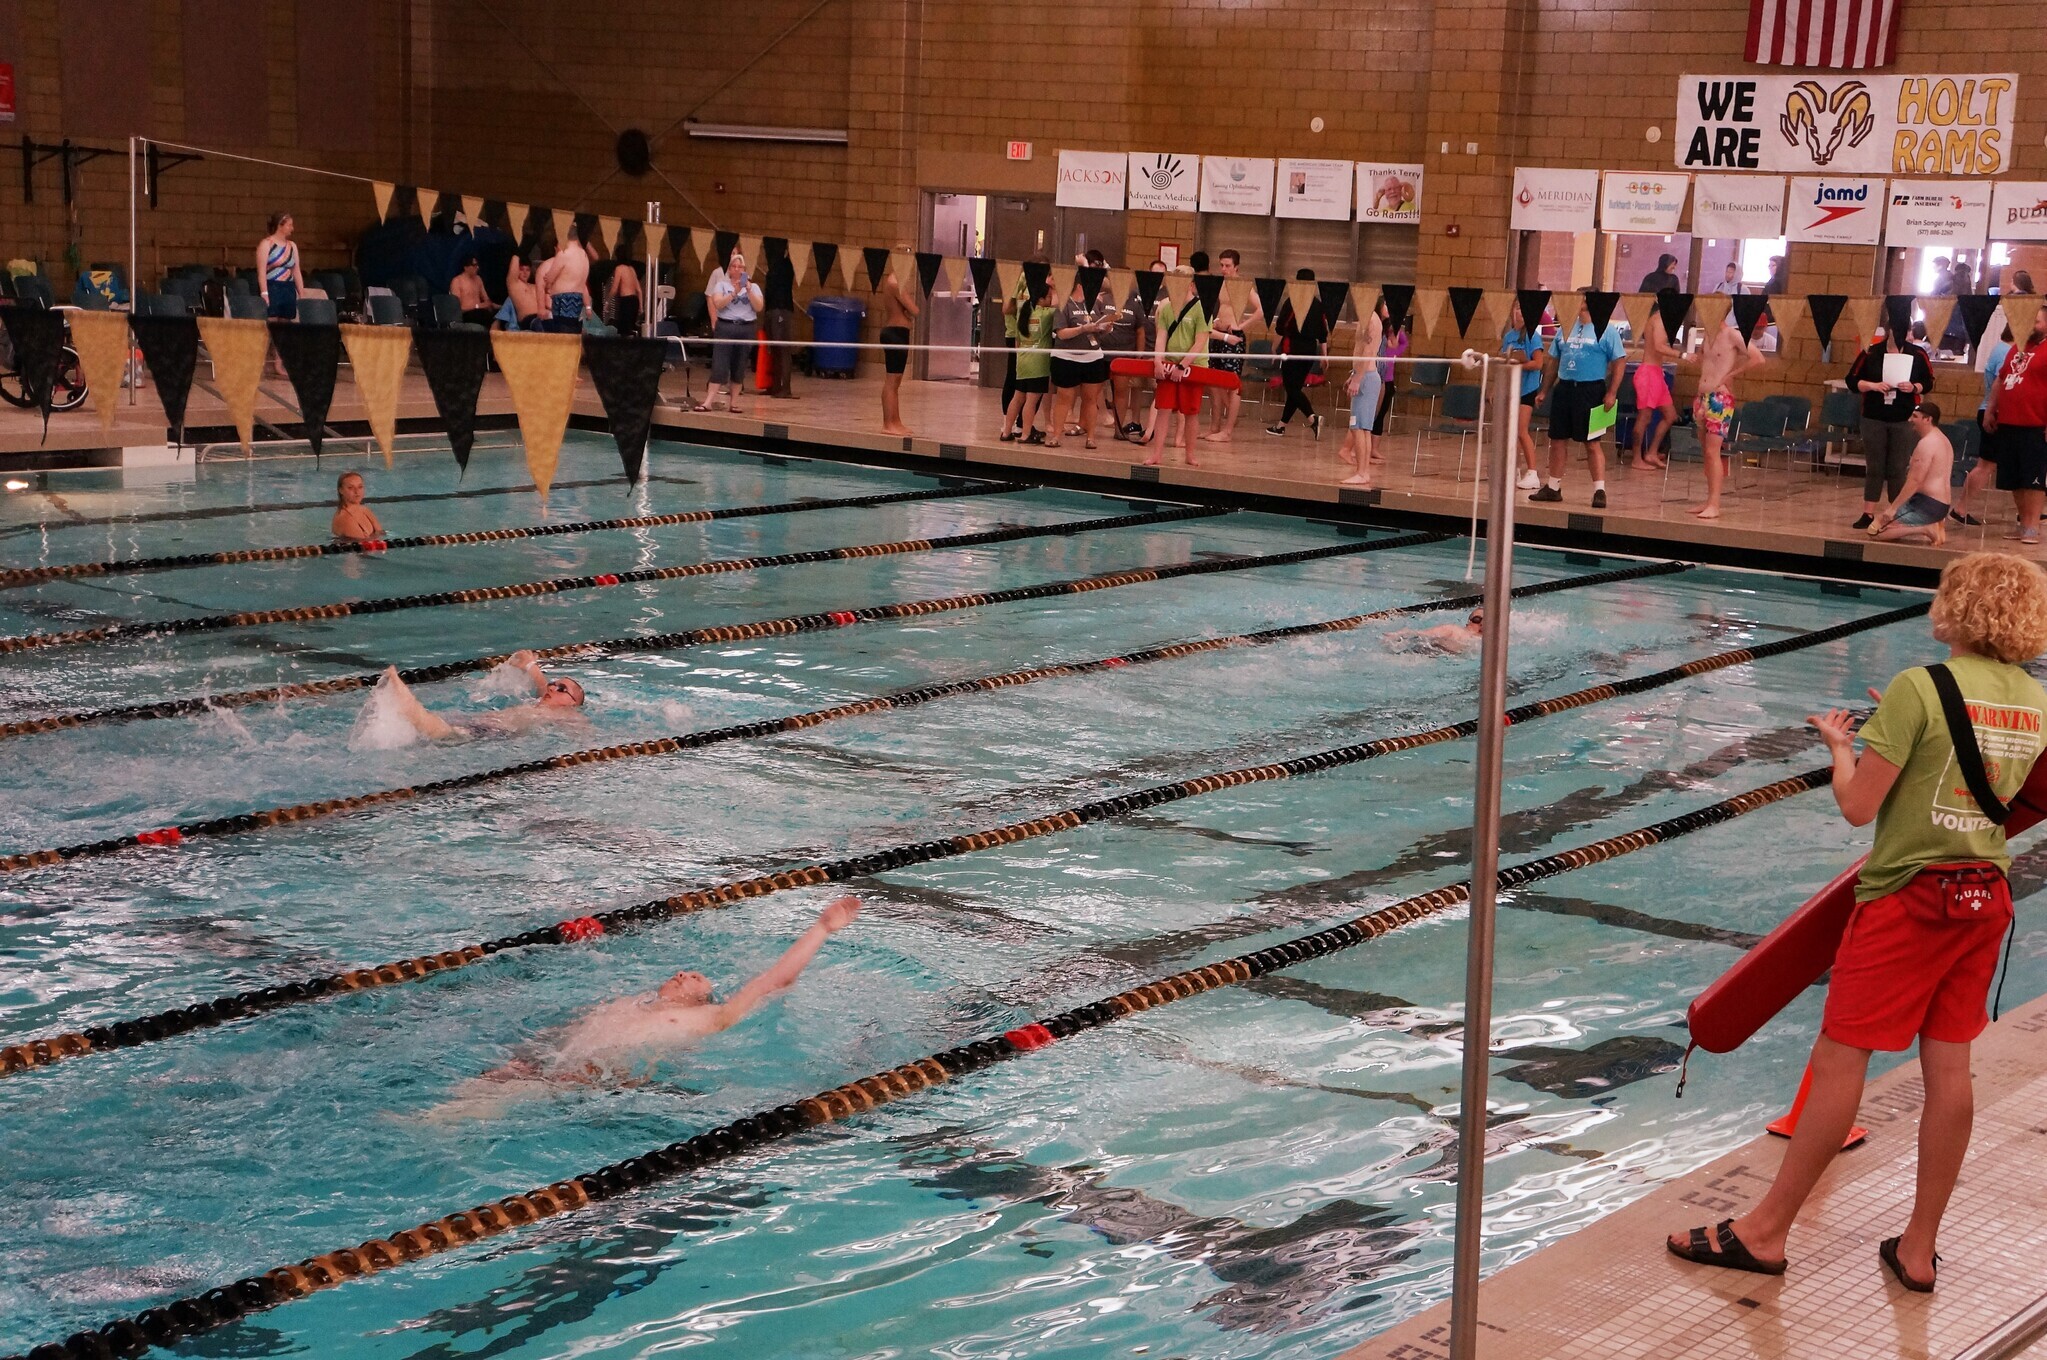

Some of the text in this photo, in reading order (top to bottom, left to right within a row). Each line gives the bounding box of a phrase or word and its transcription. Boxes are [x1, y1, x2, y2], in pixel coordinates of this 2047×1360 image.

[1698, 81, 1756, 122] WE
[1897, 78, 2011, 126] HOLT
[1011, 142, 1027, 158] EXIT
[1685, 126, 1761, 168] ARE
[1892, 129, 2001, 174] RAMS
[1059, 168, 1121, 184] JACKSON
[1369, 168, 1421, 180] Thanks Terry
[1129, 191, 1197, 202] Advance Medical
[1537, 191, 1593, 201] MERIDIAN
[1814, 182, 1867, 205] jamd
[1143, 200, 1179, 211] Massage
[1366, 207, 1420, 219] Go Rams!!!
[1712, 202, 1780, 212] THE ENGLISH INN
[1945, 220, 1966, 228] Agency
[1966, 704, 2040, 733] WARNING
